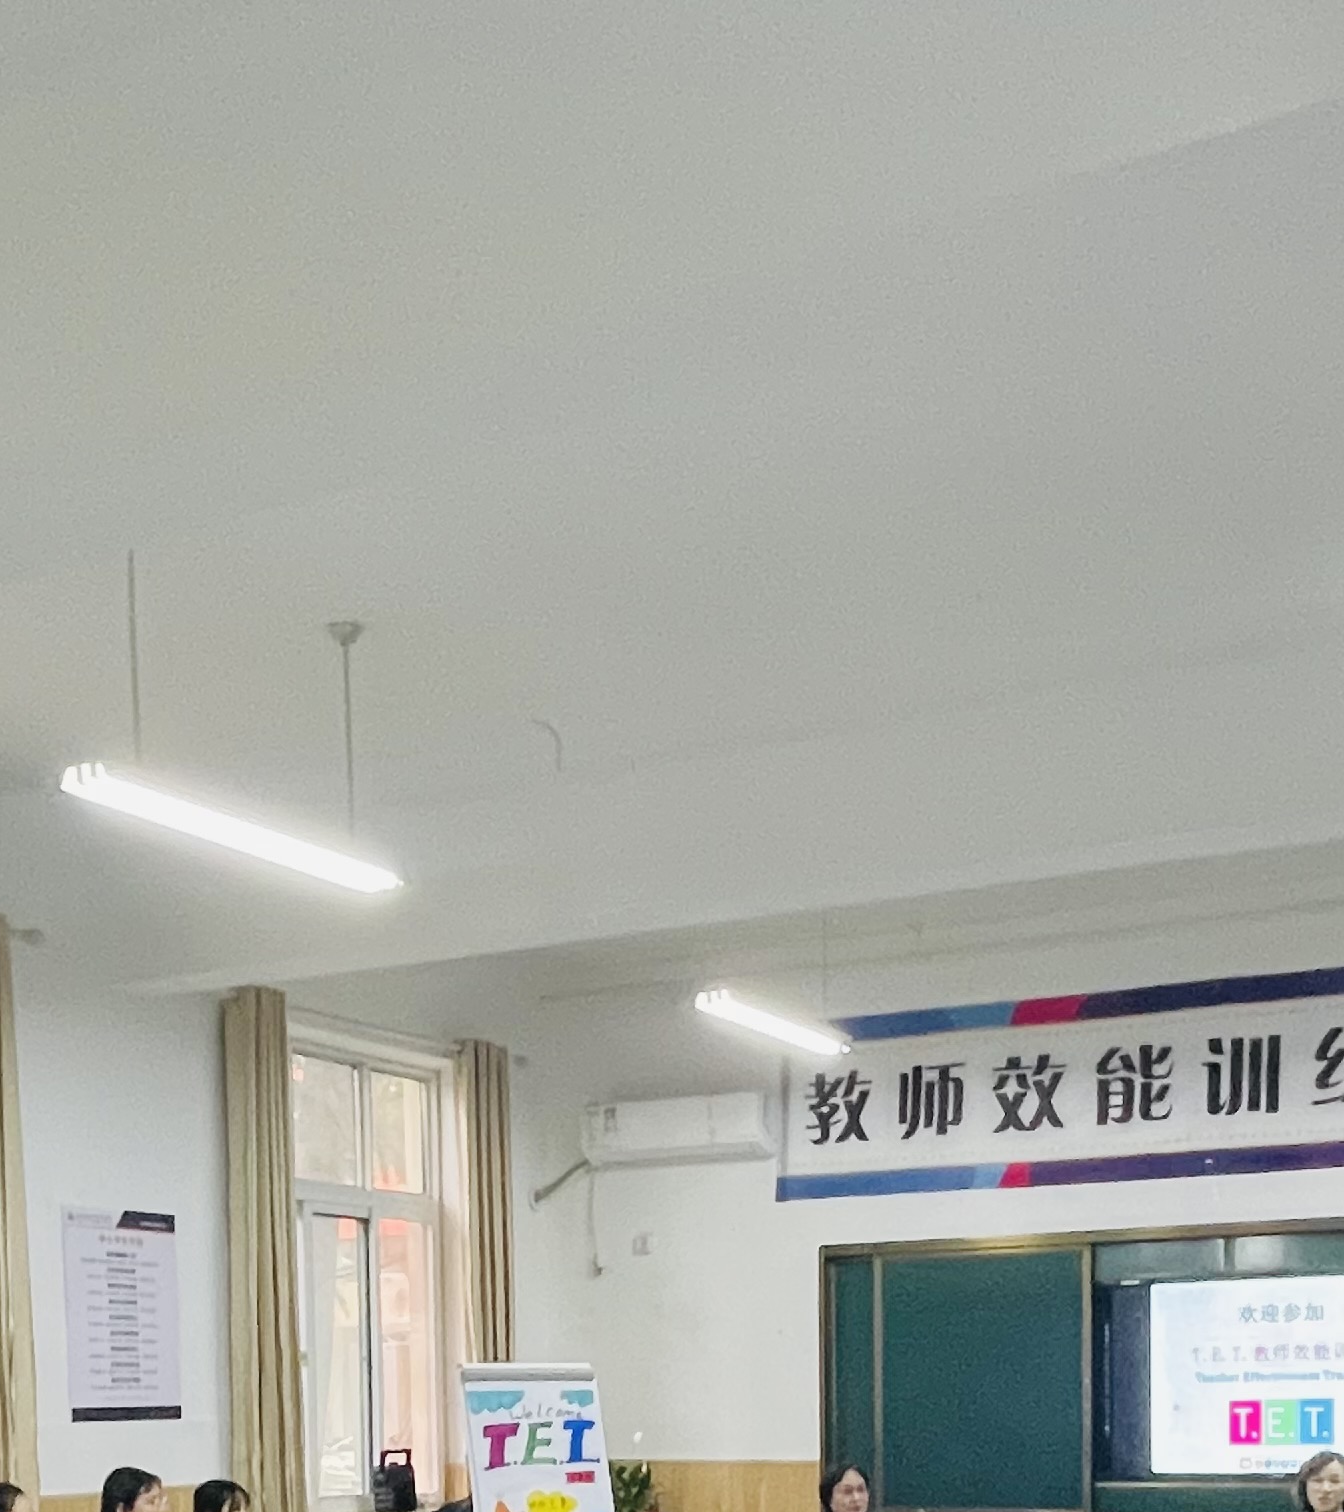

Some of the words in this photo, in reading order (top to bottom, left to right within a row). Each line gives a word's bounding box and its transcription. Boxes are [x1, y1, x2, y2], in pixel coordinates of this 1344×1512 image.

[1237, 1301, 1325, 1324] 欢迎参加
[1232, 1406, 1330, 1440] T.E.T.
